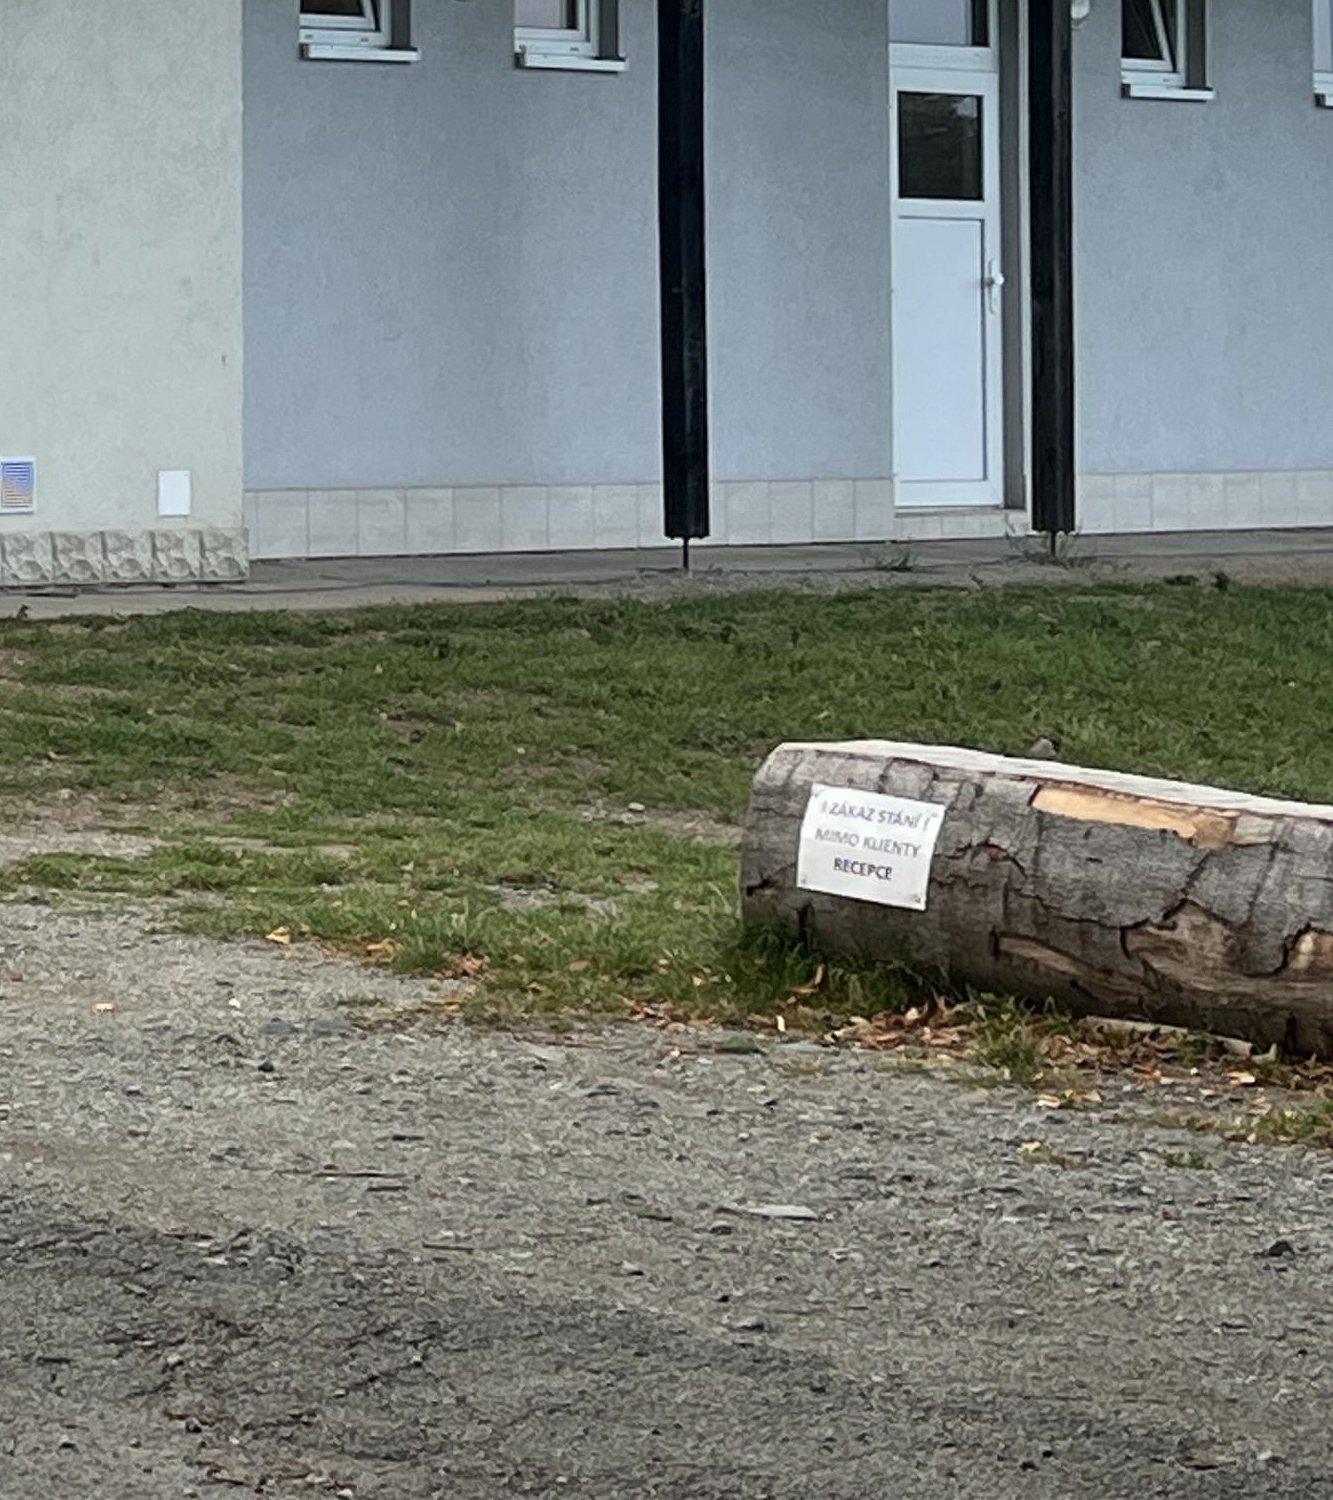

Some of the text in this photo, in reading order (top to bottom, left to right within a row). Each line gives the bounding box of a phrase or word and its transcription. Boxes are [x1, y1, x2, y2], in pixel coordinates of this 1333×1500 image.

[815, 827, 921, 857] MIMO KLIENTY
[833, 857, 893, 881] RECEPCE
